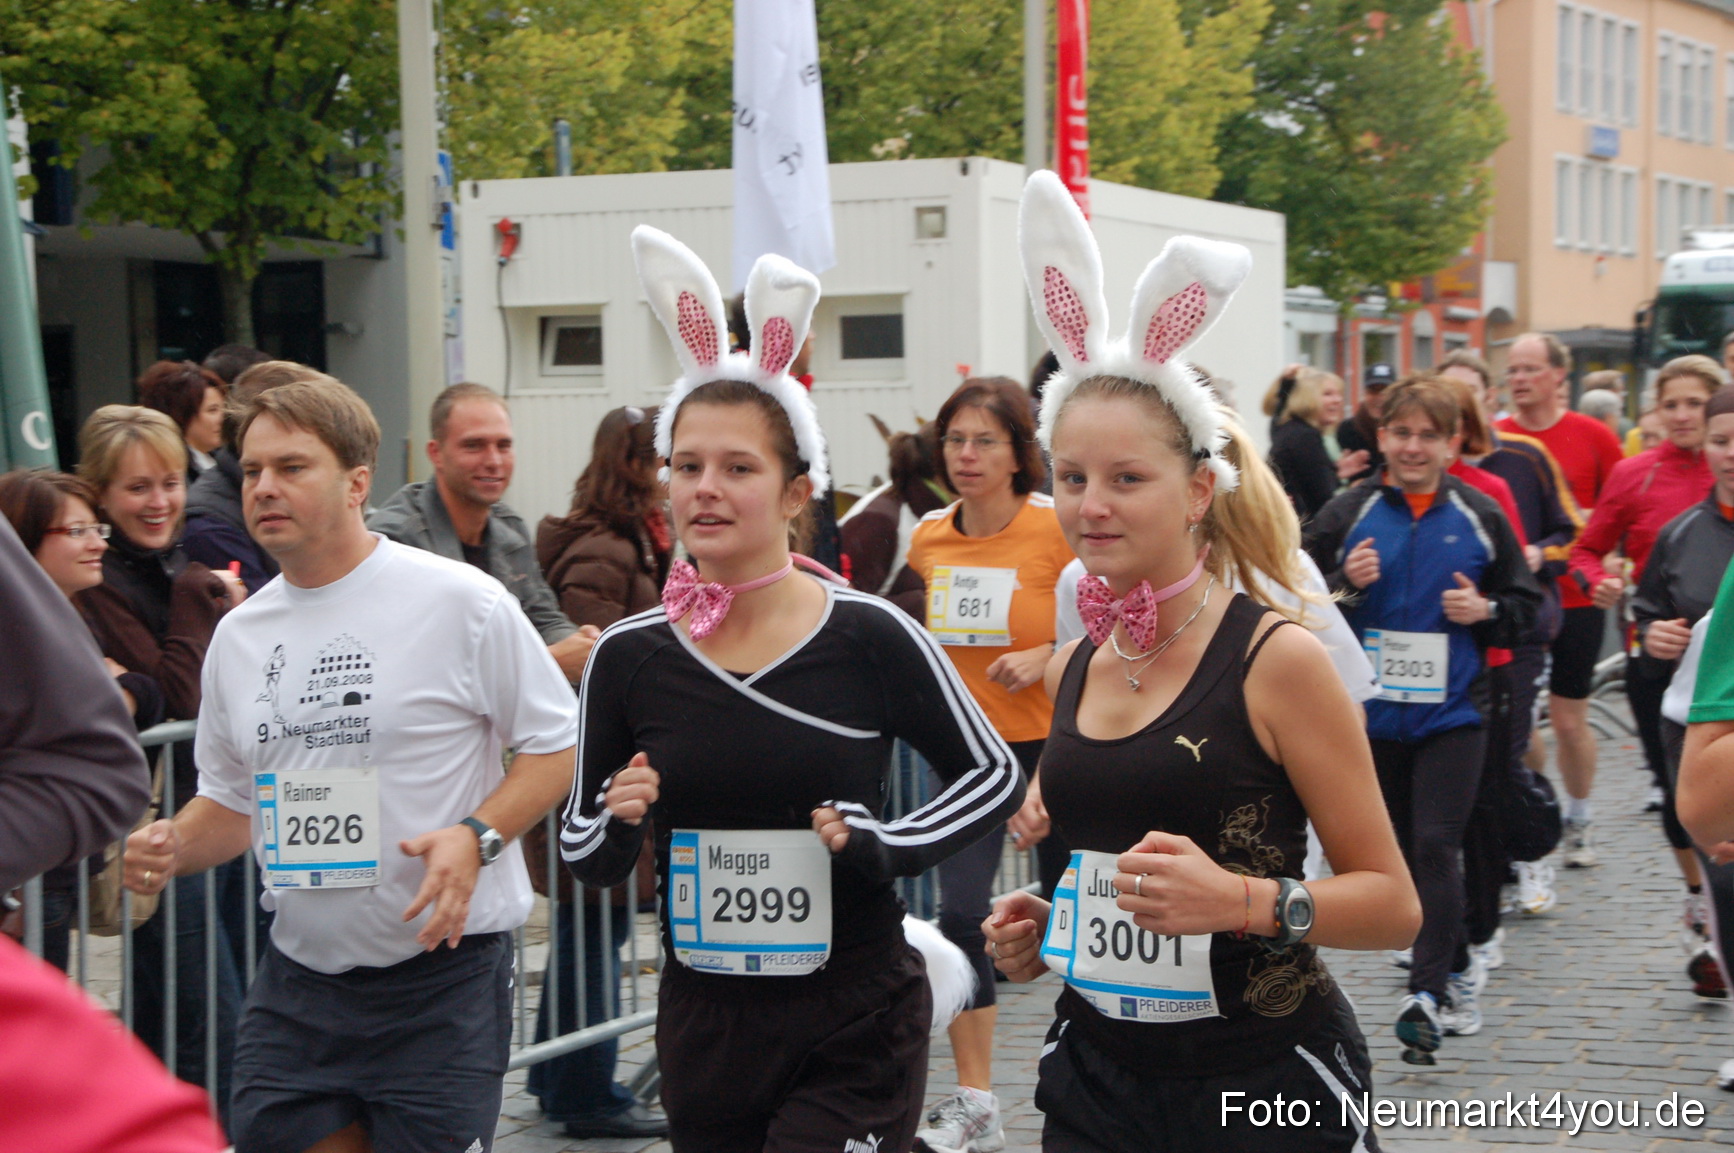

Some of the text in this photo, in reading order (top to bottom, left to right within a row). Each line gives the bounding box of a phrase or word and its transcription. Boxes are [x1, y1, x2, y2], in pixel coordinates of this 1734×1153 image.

[958, 597, 992, 618] 681
[1384, 658, 1434, 678] 2303
[307, 673, 374, 691] 21.09.2008
[282, 714, 370, 738] Neumarkter
[305, 728, 371, 749] Stadtlauf
[283, 781, 332, 802] Rainer
[286, 813, 364, 846] 2626
[708, 845, 770, 875] Magga
[679, 884, 688, 902] D
[712, 887, 811, 923] 2999
[1059, 910, 1067, 930] D
[1088, 917, 1183, 967] 3001
[762, 952, 826, 966] PFLEIDERER
[1139, 998, 1212, 1013] PFLEIDERER
